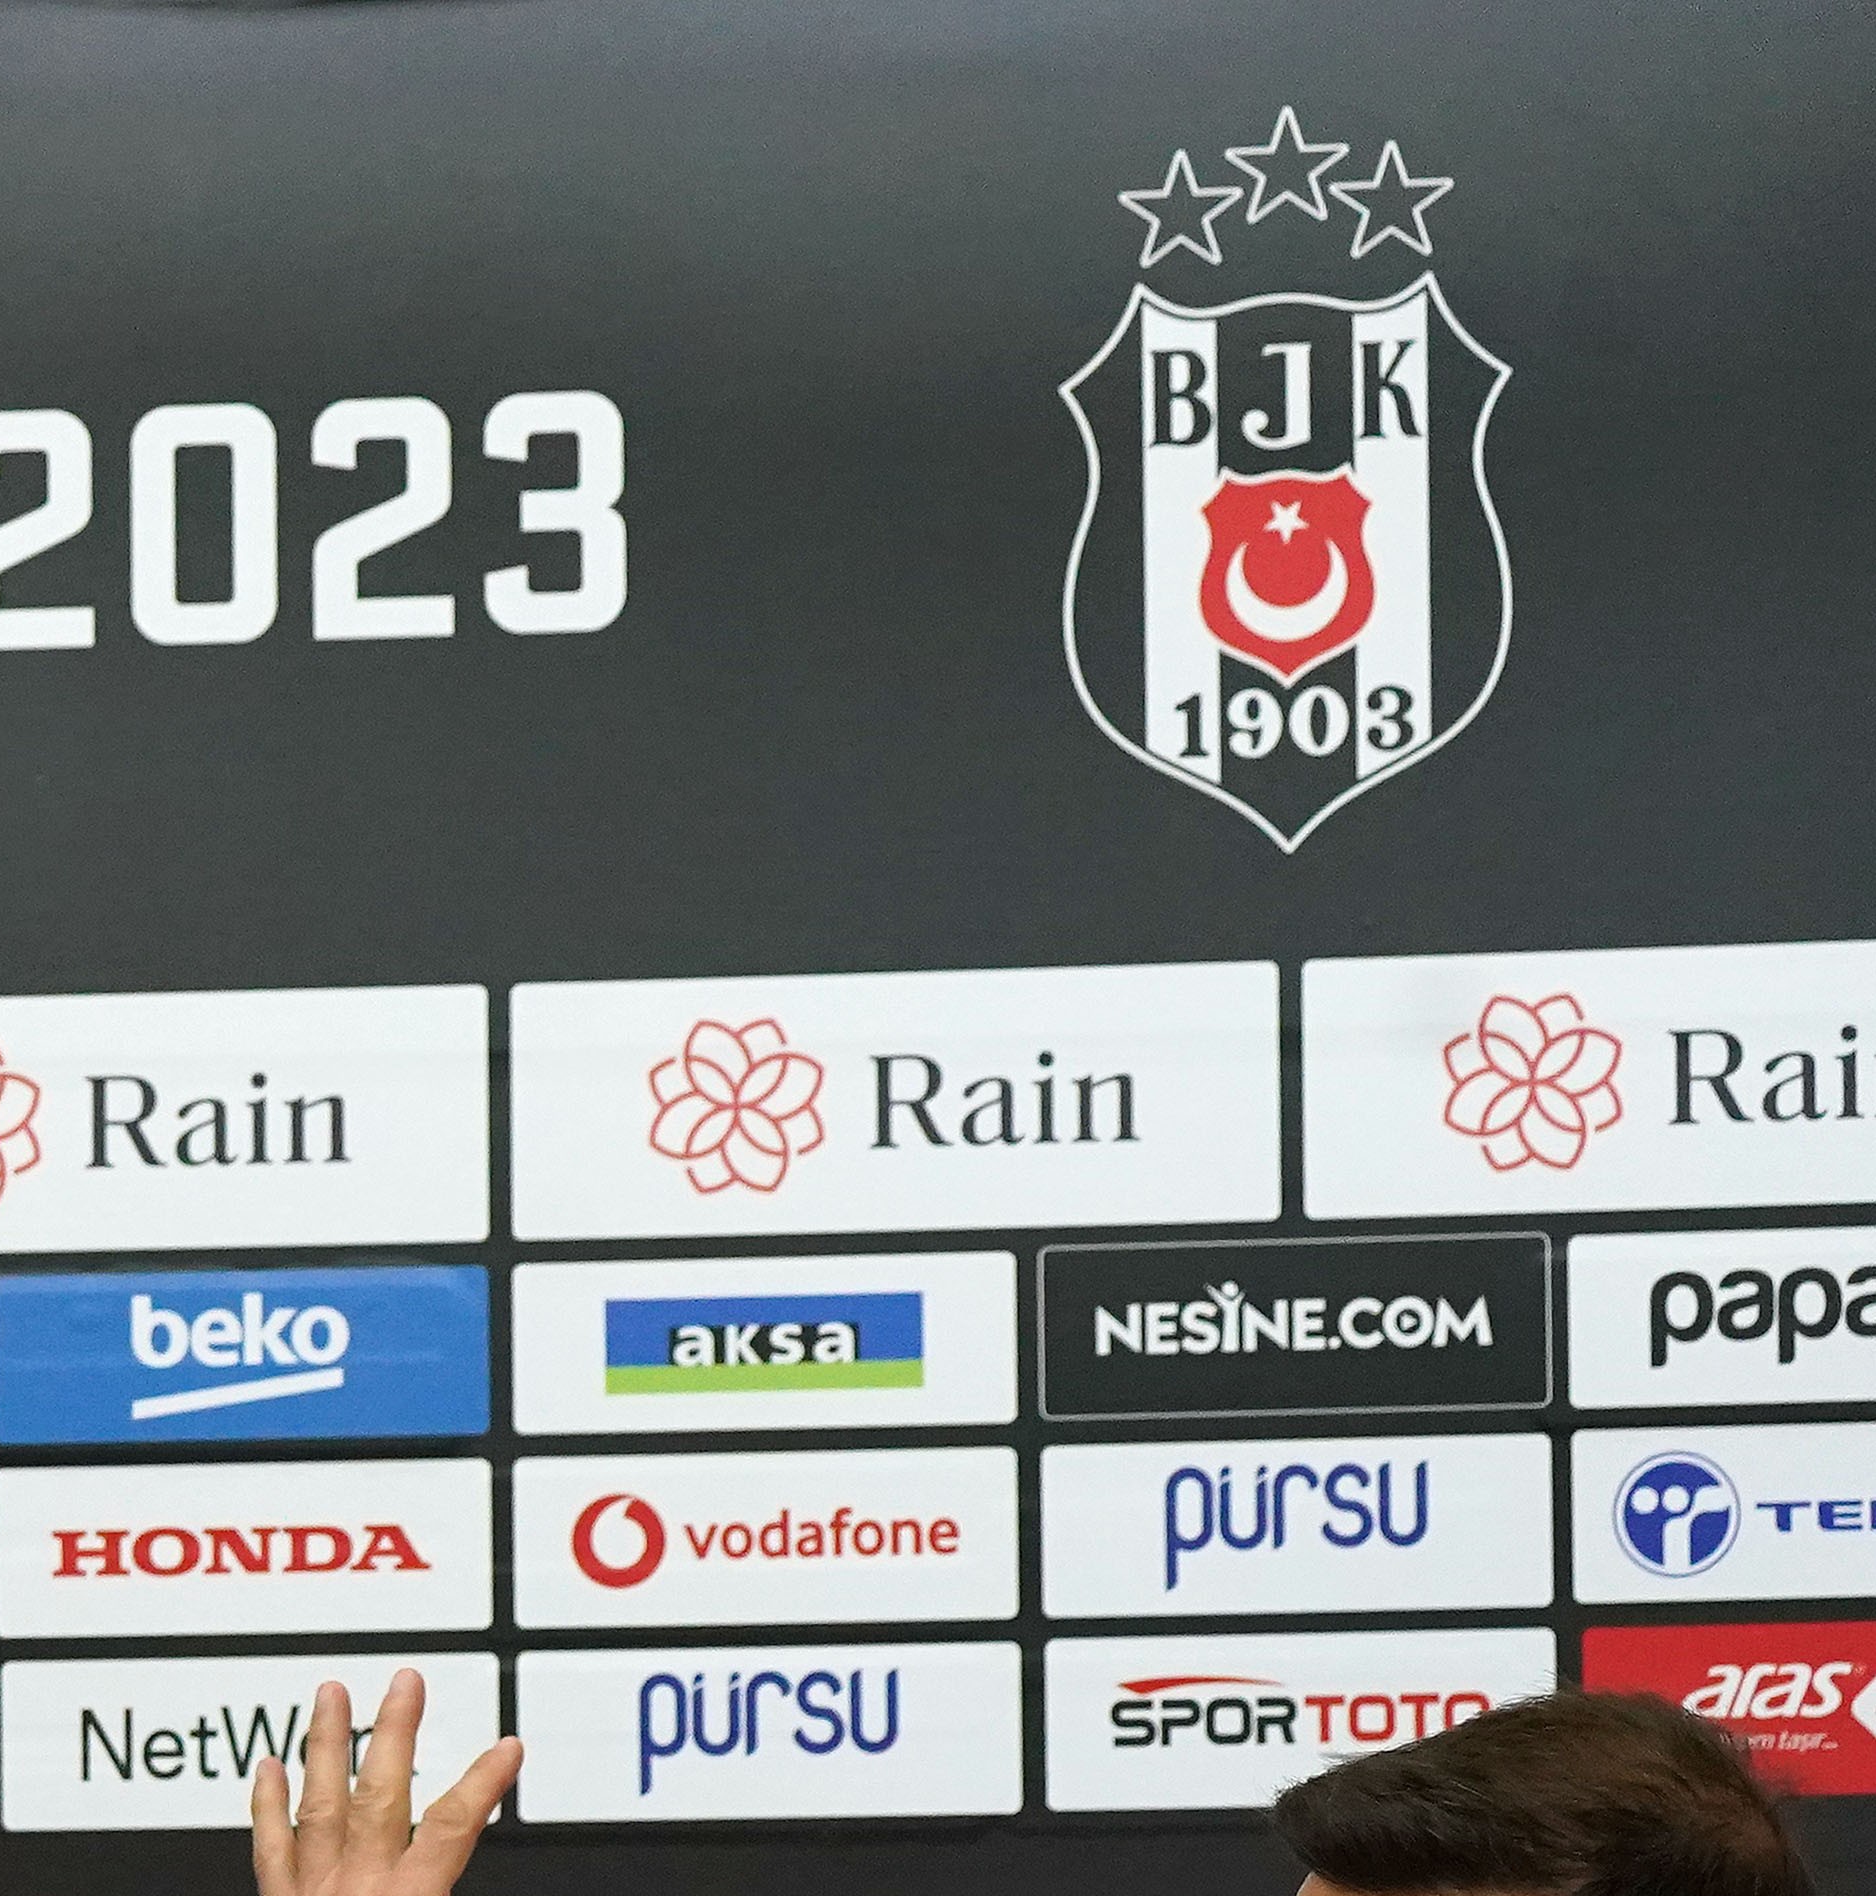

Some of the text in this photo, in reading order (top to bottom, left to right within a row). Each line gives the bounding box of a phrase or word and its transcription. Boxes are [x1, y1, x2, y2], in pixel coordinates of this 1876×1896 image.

[1172, 678, 1428, 766] 1903
[87, 1072, 348, 1168] Rain
[871, 1051, 1138, 1149] Rain
[130, 1292, 351, 1373] beko
[672, 1322, 860, 1364] aksa
[52, 1524, 431, 1577] HONDA
[684, 1507, 959, 1560] vodafone
[1681, 1661, 1854, 1721] aras
